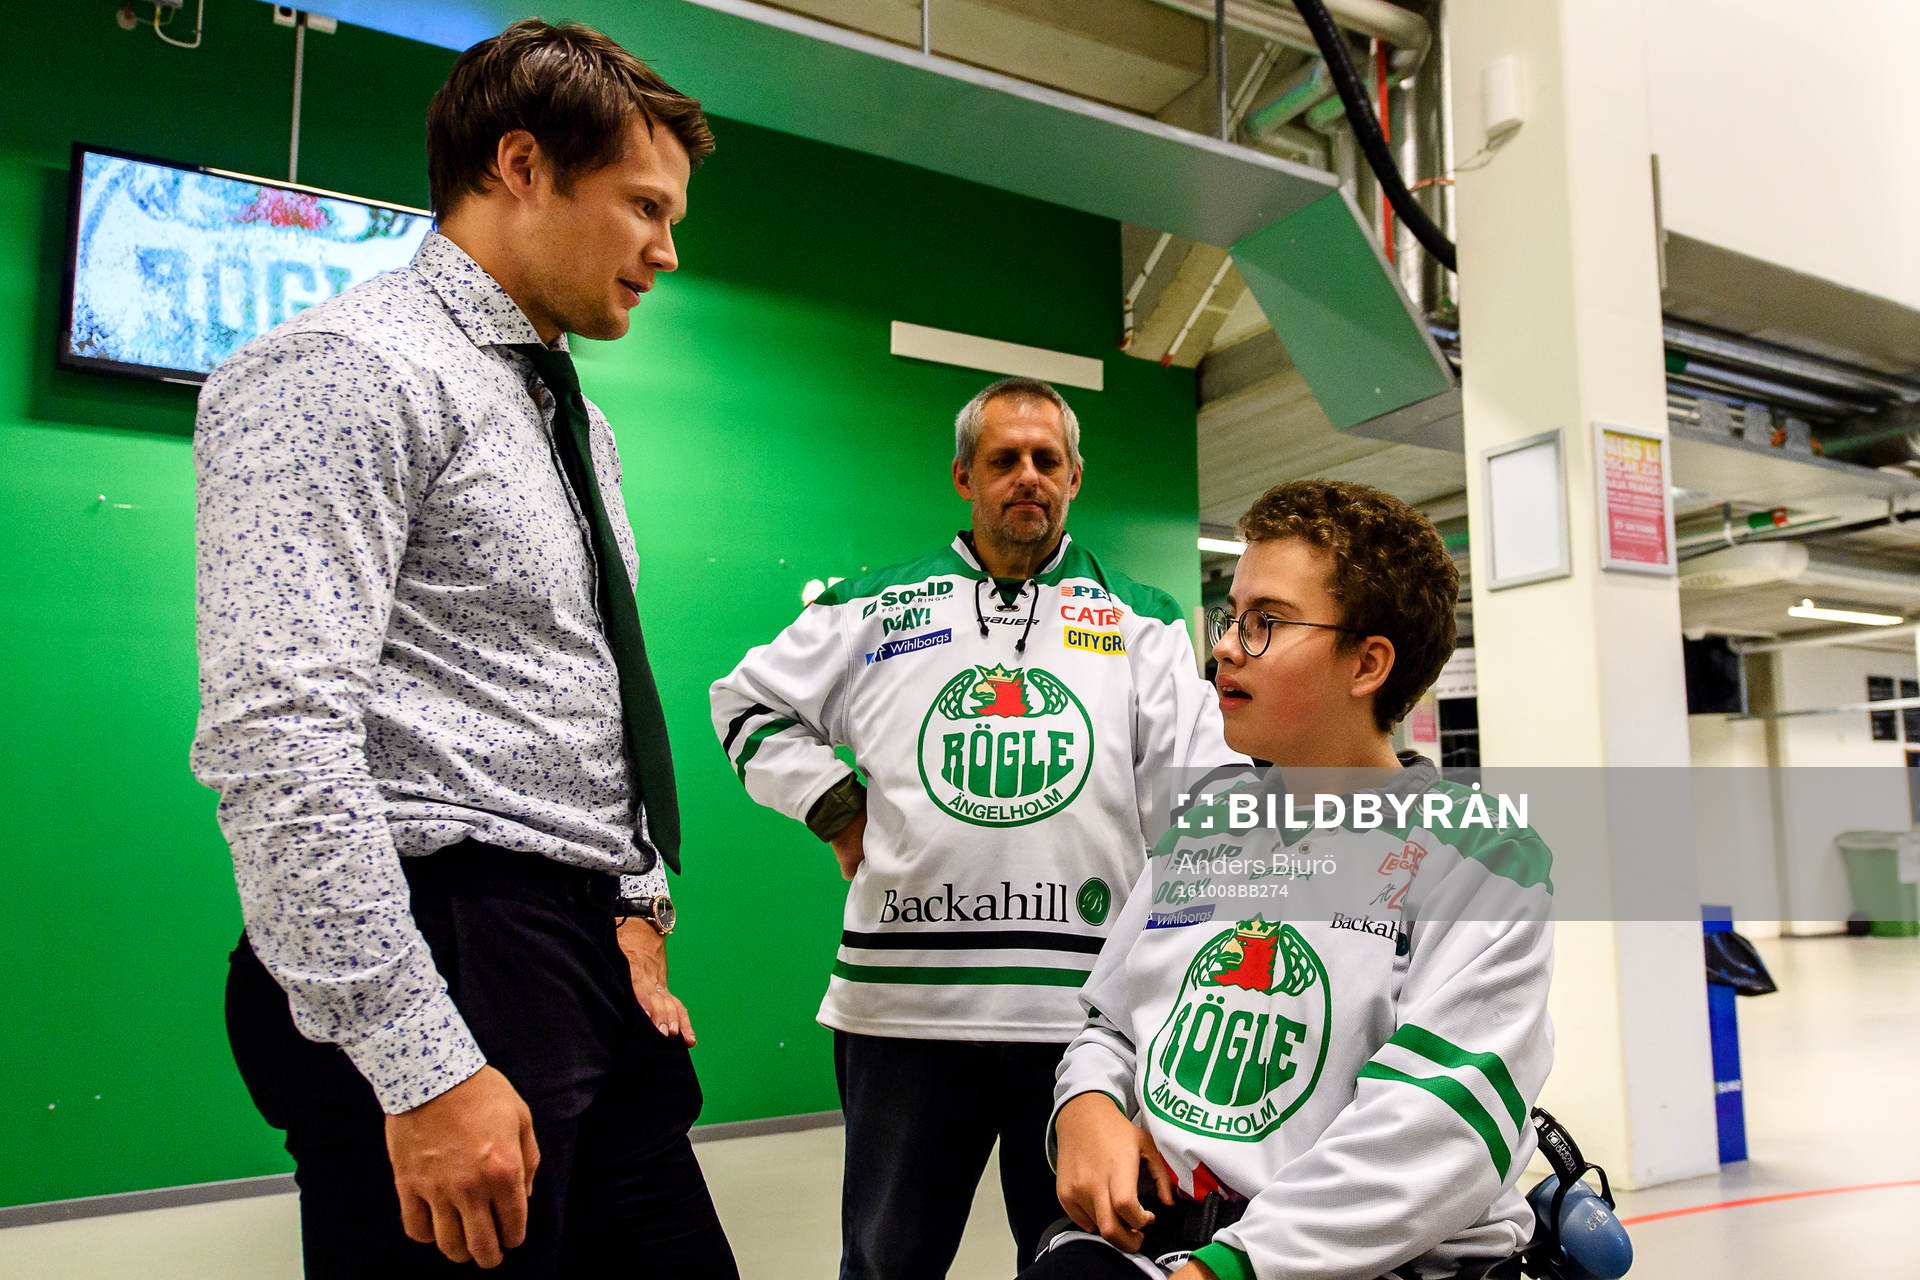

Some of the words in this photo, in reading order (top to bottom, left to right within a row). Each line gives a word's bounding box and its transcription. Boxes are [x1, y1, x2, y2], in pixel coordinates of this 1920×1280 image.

[881, 581, 954, 607] SOLID
[890, 633, 949, 654] Wihlborgs
[1068, 630, 1100, 649] CITY
[1102, 635, 1126, 652] GR
[941, 723, 1075, 798] RÖGLE
[948, 788, 1064, 821] ÄNGELHOLM
[879, 882, 1070, 923] Backahill
[1157, 911, 1212, 926] Wihlborgs
[1160, 993, 1307, 1107] RÖGLE
[1152, 1080, 1279, 1135] ÄNGELHOLM
